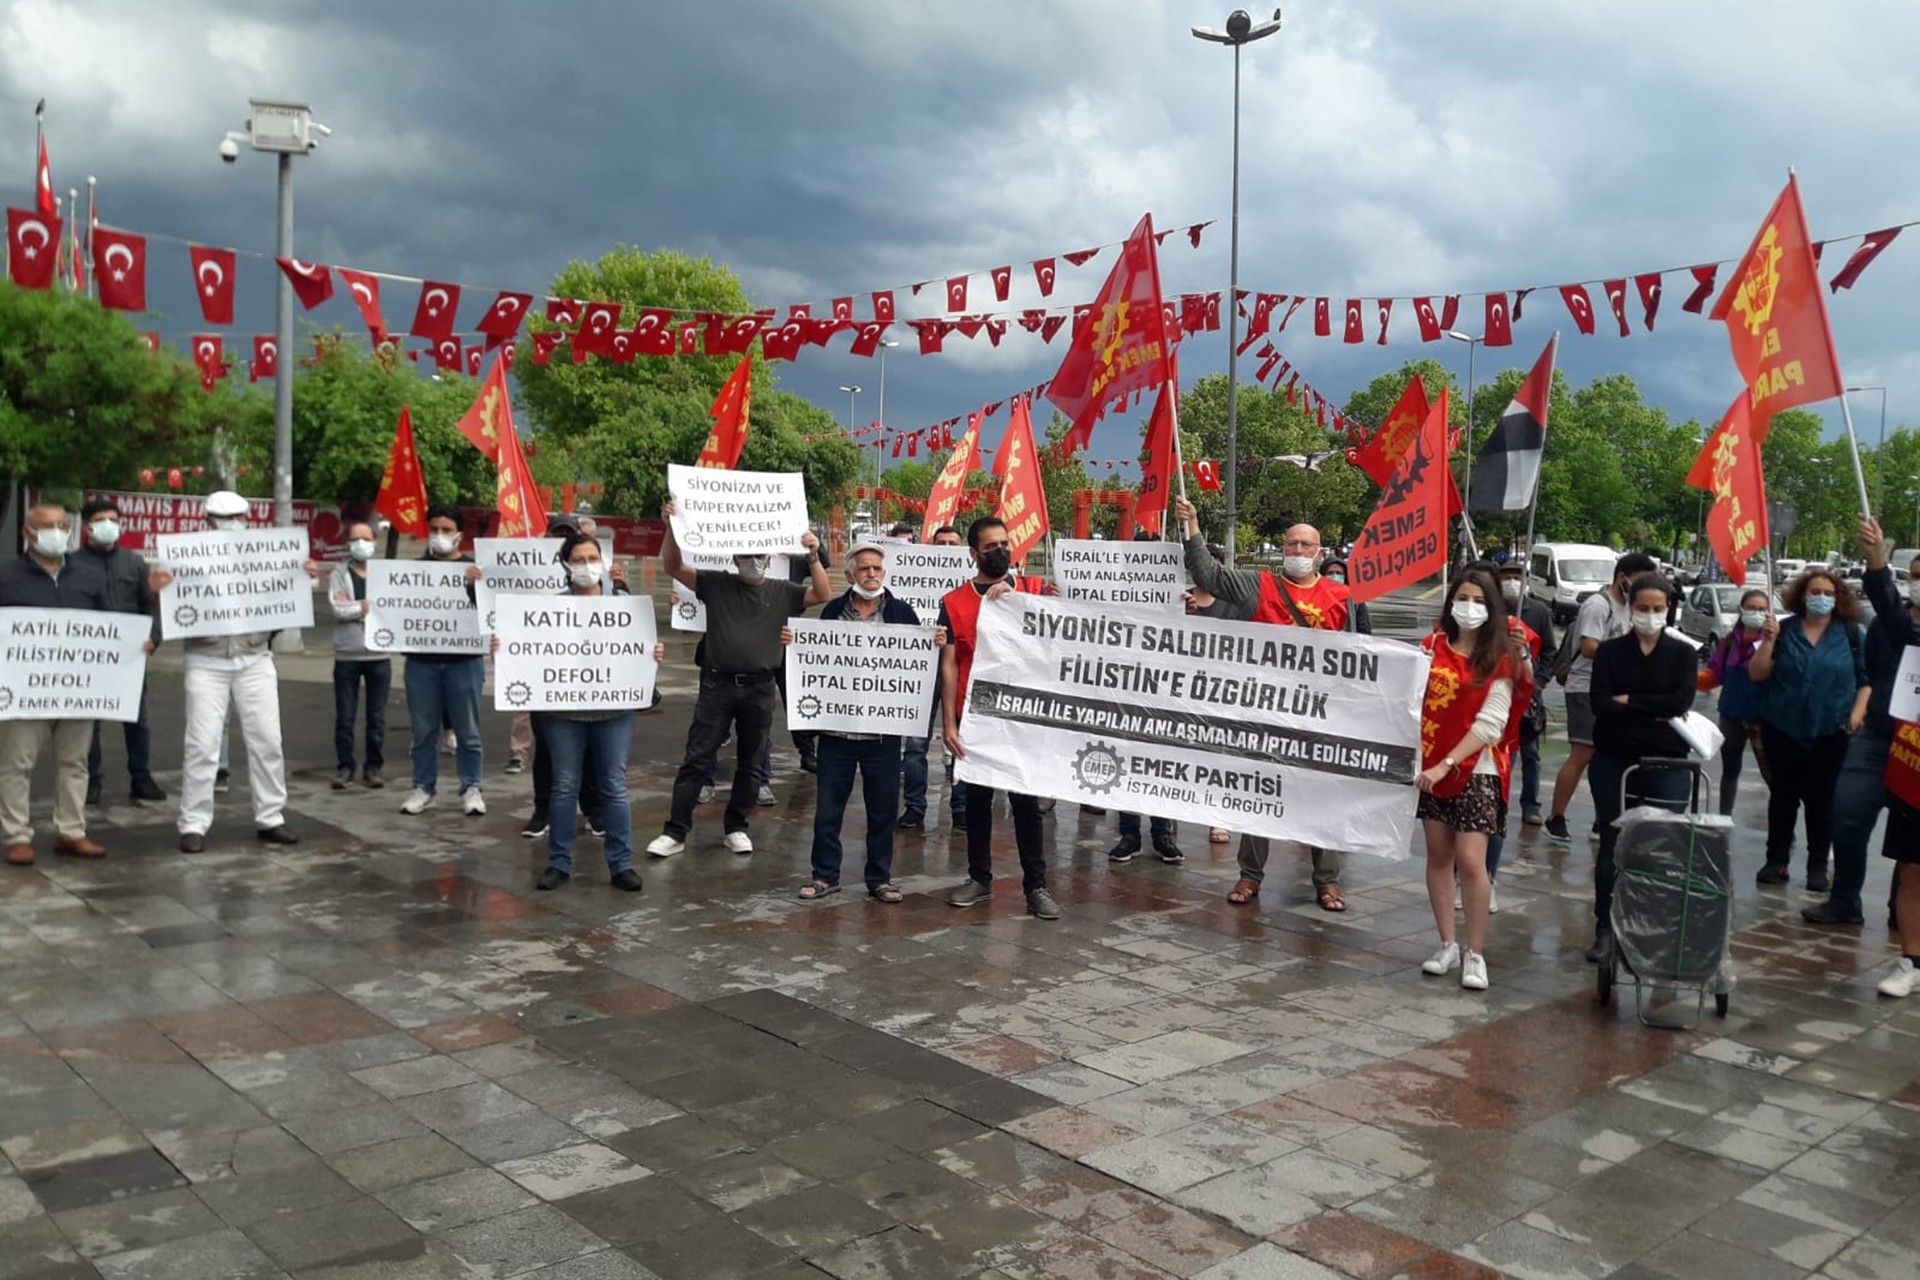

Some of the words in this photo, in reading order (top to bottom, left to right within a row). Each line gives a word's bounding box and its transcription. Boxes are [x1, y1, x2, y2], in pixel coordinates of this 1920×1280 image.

[687, 476, 761, 494] SİYONİZM
[765, 483, 785, 494] VE
[684, 498, 792, 514] EMPERYALİZM
[697, 519, 781, 533] YENİLECEK!
[167, 541, 231, 560] İSRAİL'LE
[234, 538, 301, 555] YAPILAN
[709, 540, 745, 548] EMEK
[748, 534, 795, 548] PARTİSİ
[496, 547, 547, 566] KATİL
[896, 552, 962, 569] SİYONİZM
[1061, 548, 1121, 564] İSRAİL'LE
[1124, 553, 1179, 565] YAPILAN
[172, 563, 204, 578] TÜM
[208, 560, 299, 575] ANLAŞMALAR
[1063, 567, 1092, 580] TÜM
[1094, 571, 1176, 584] ANLAŞMALAR
[177, 582, 223, 599] İPTAL
[227, 576, 294, 596] EDİLSİN!
[389, 570, 434, 587] KATİL
[891, 575, 968, 589] EMPERYALİ
[1067, 586, 1107, 601] İPTAL
[1111, 587, 1171, 604] EDİLSİN!
[204, 606, 241, 621] EMEK
[245, 600, 296, 617] PARTİSİ
[524, 607, 582, 628] KATİL
[588, 611, 632, 628] ABD
[12, 619, 60, 637] KATİL
[66, 619, 121, 640] İSRAİL
[403, 618, 458, 632] DEFOL!
[405, 636, 439, 647] EMEK
[441, 636, 484, 648] PARTİSİ
[508, 639, 645, 656] ORTADOĞU'DAN
[794, 628, 863, 648] İSRAİL'LE
[867, 635, 932, 651] YAPILAN
[1022, 609, 1137, 648] SİYONİST
[1141, 624, 1316, 673] SALDIRILARA
[1322, 648, 1379, 682] SON
[6, 644, 120, 664] FİLİSTİN'DEN
[797, 650, 829, 666] TÜM
[833, 655, 928, 671] ANLAŞMALAR
[28, 673, 92, 688] DEFOL!
[543, 667, 611, 684] DEFOL!
[801, 671, 847, 690] İPTAL
[852, 675, 922, 695] EDİLSİN!
[19, 696, 60, 709] EMEK
[64, 695, 121, 710] PARTİSİ
[545, 690, 587, 703] EMEK
[591, 687, 645, 702] PARTİSİ
[1189, 670, 1330, 720] ÖZGÜRLÜK
[826, 702, 864, 716] EMEK
[868, 705, 919, 720] PARTİSİ
[995, 691, 1046, 717] İSRAİL
[1049, 699, 1074, 722] İLE
[1075, 707, 1142, 735] YAPILAN
[1144, 716, 1260, 750] ANLAŞMALAR
[1261, 732, 1310, 760] İPTAL
[1313, 743, 1389, 773] EDİLSİN!
[1084, 760, 1116, 776] EMEP
[1130, 756, 1190, 782] EMEK
[1194, 765, 1282, 797] PARTİSİ
[1126, 777, 1201, 804] İSTANBUL
[1204, 789, 1217, 807] İL
[1221, 792, 1285, 818] ÖRGÜTÜ
